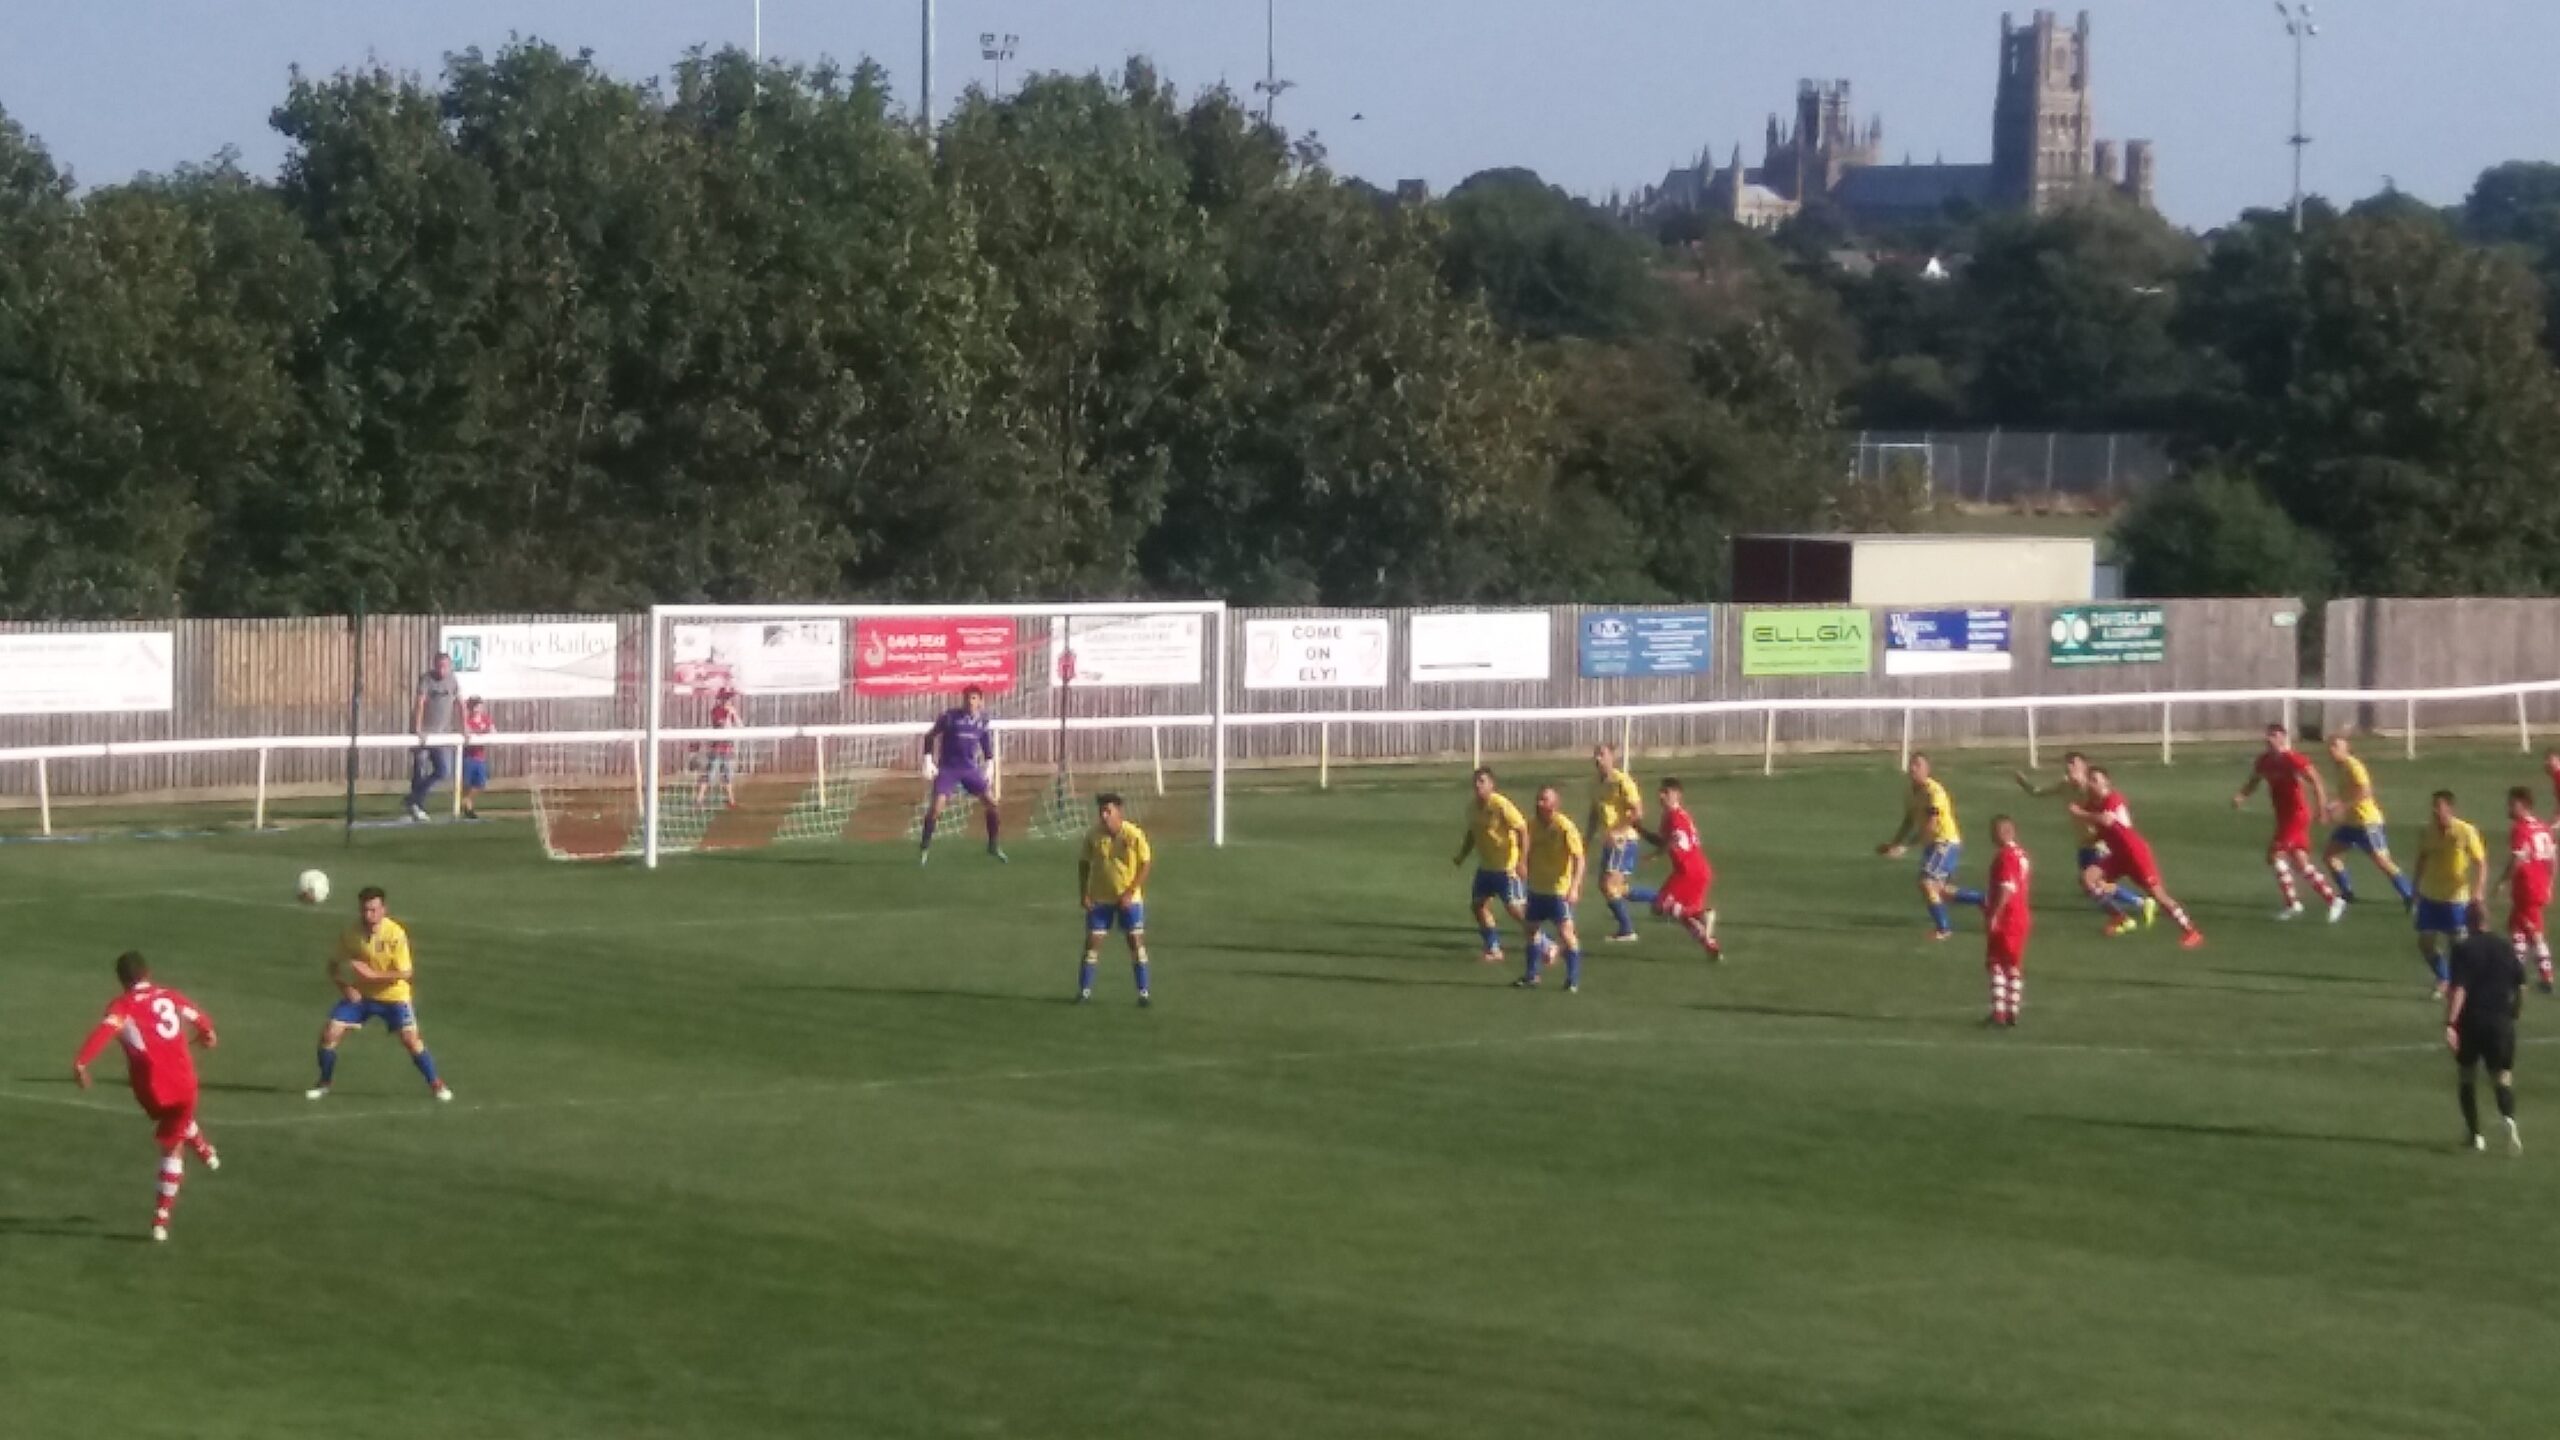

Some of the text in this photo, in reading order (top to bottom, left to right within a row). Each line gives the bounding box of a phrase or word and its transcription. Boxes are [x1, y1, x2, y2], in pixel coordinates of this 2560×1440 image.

[1292, 625, 1342, 640] COME
[487, 630, 610, 656] Price Bailey
[1306, 646, 1331, 660] ON
[1299, 667, 1337, 681] ELY!
[152, 998, 180, 1039] 3
